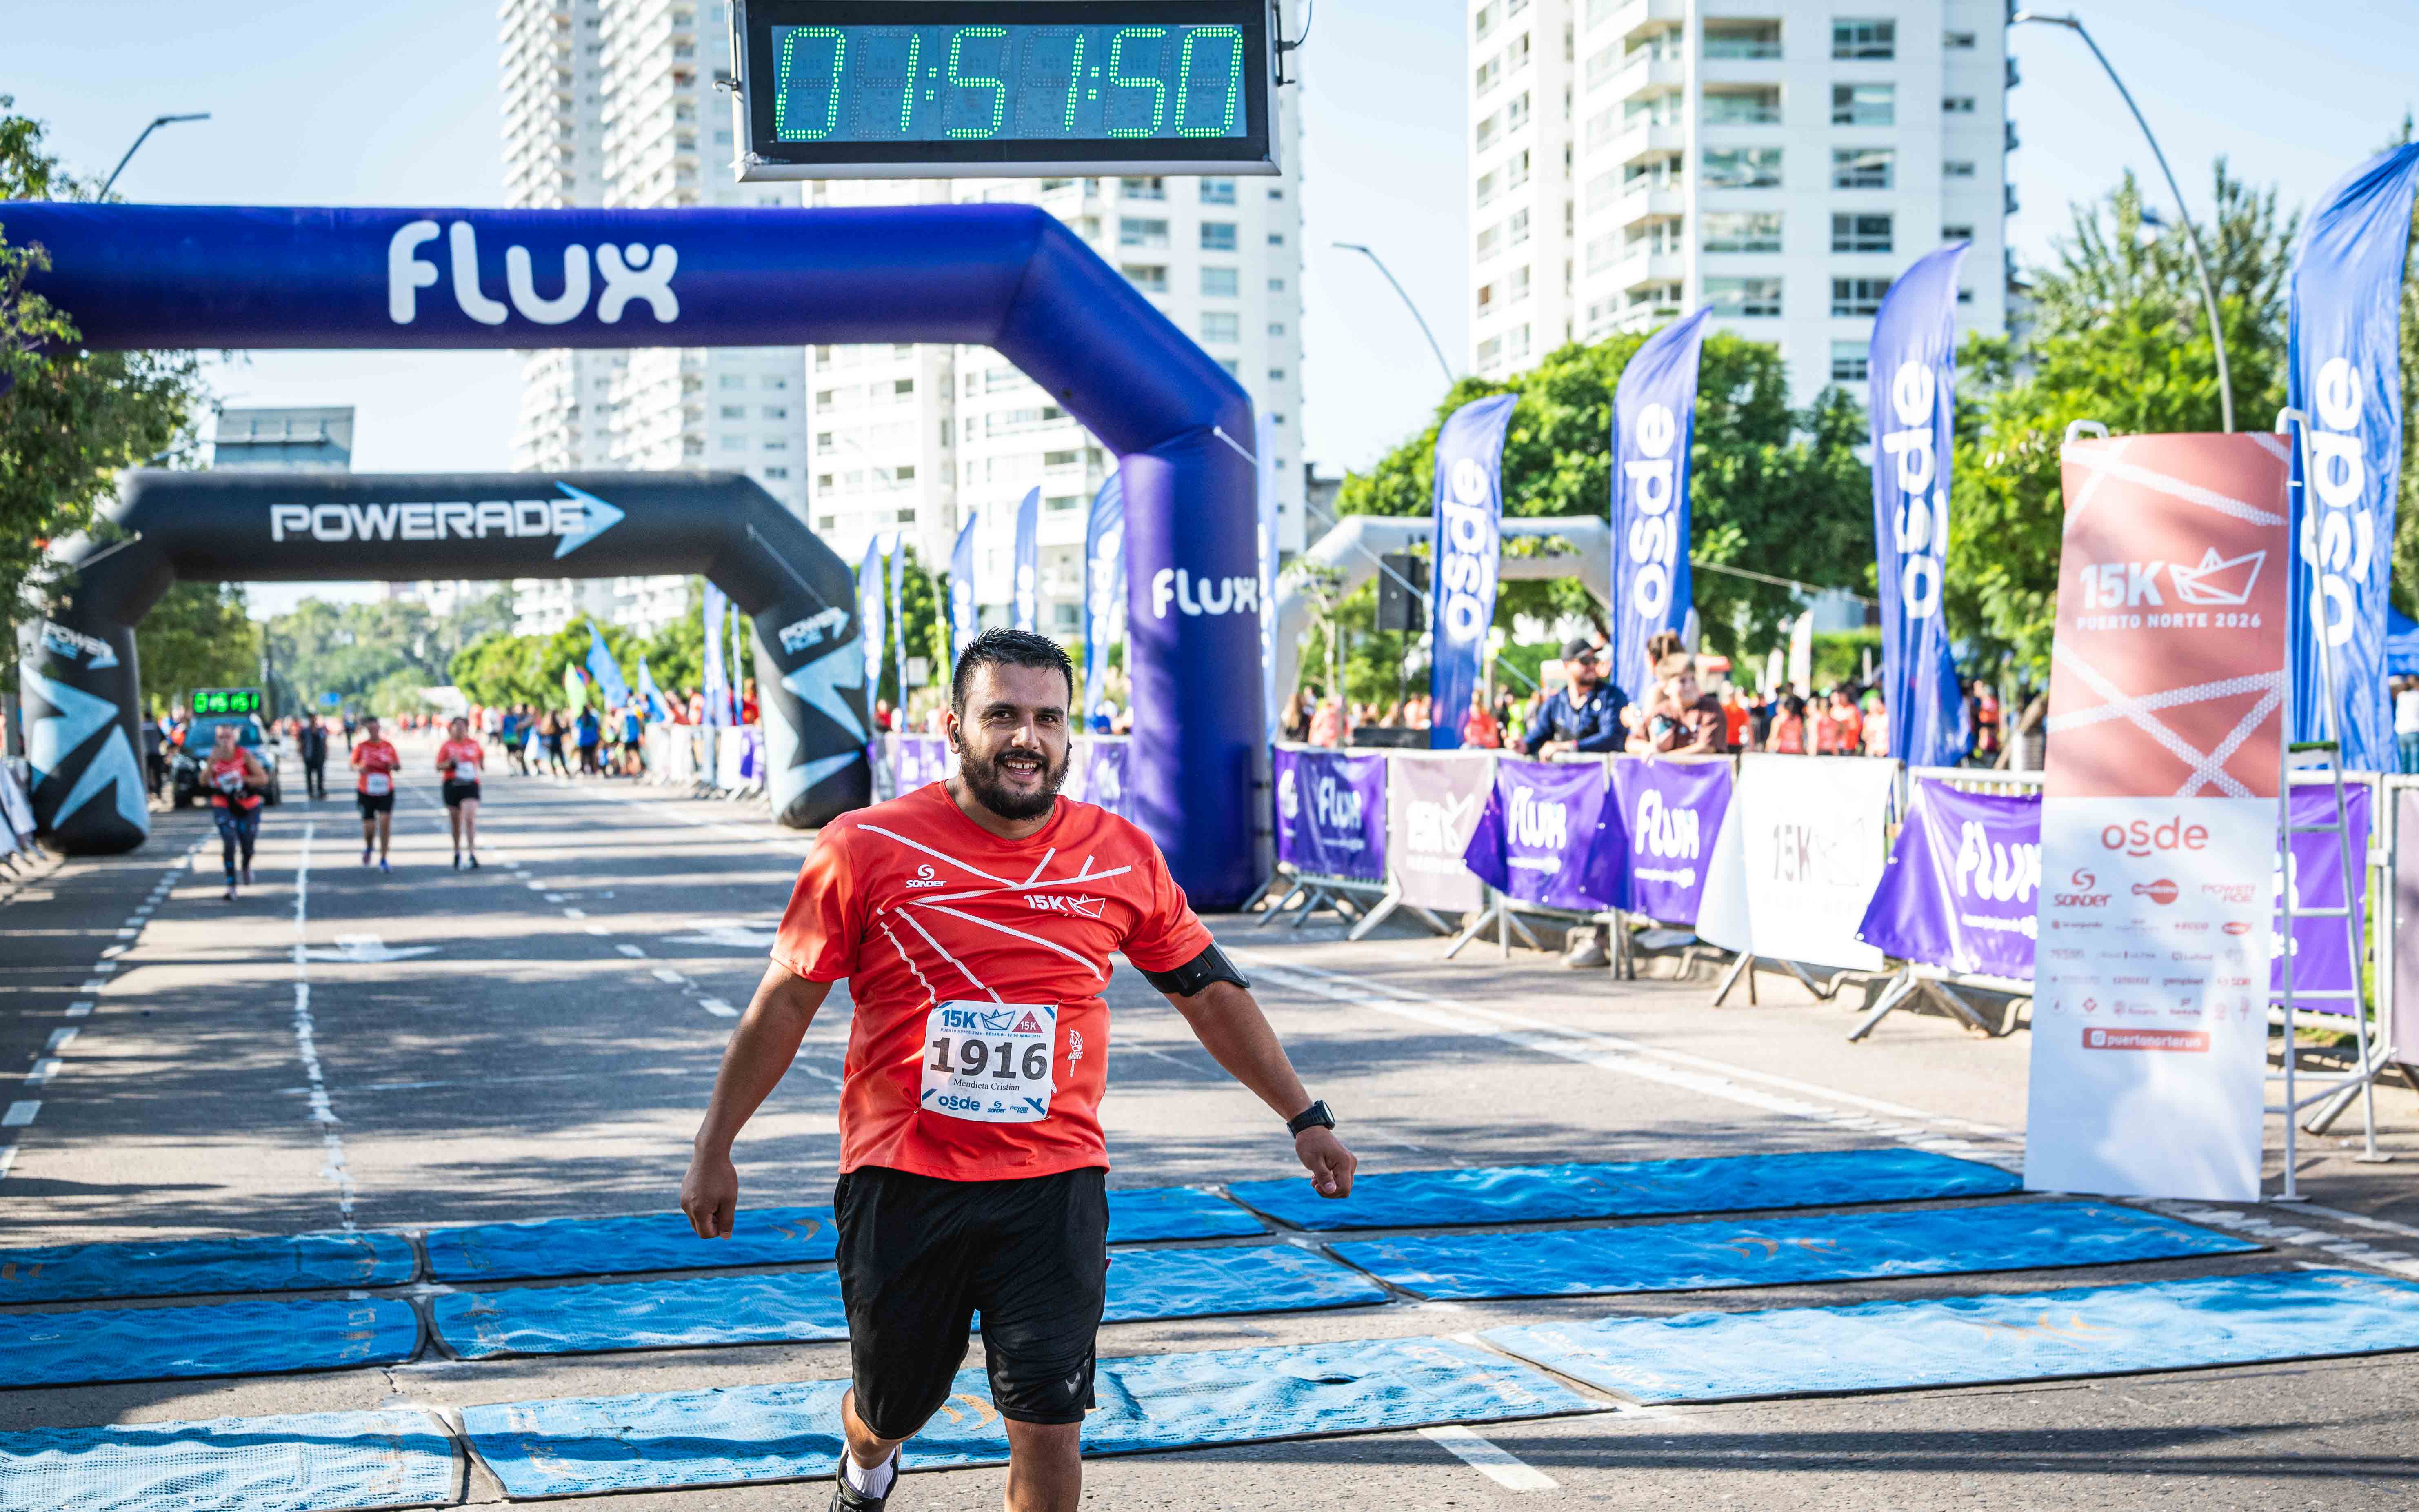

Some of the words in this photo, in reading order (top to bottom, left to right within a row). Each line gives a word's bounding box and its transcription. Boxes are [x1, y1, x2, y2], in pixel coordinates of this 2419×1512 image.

[775, 27, 1243, 139] 01:51:50
[1882, 360, 1948, 619] osde
[270, 500, 584, 542] POWERADE
[1625, 402, 1677, 620] osde
[1441, 458, 1492, 642] osde
[2079, 561, 2165, 609] 15K
[2076, 613, 2141, 631] PUERTO
[2147, 613, 2208, 628] NORTE
[2215, 613, 2261, 628] 2026
[1773, 824, 1813, 884] 15K
[2101, 816, 2209, 857] osde
[1023, 895, 1068, 911] 15K
[942, 1010, 978, 1029] 15K
[1020, 1021, 1037, 1030] 15K
[929, 1037, 1048, 1080] 1916
[938, 1095, 980, 1110] osde
[953, 1078, 988, 1090] Mendieta
[991, 1082, 1020, 1091] Cristian
